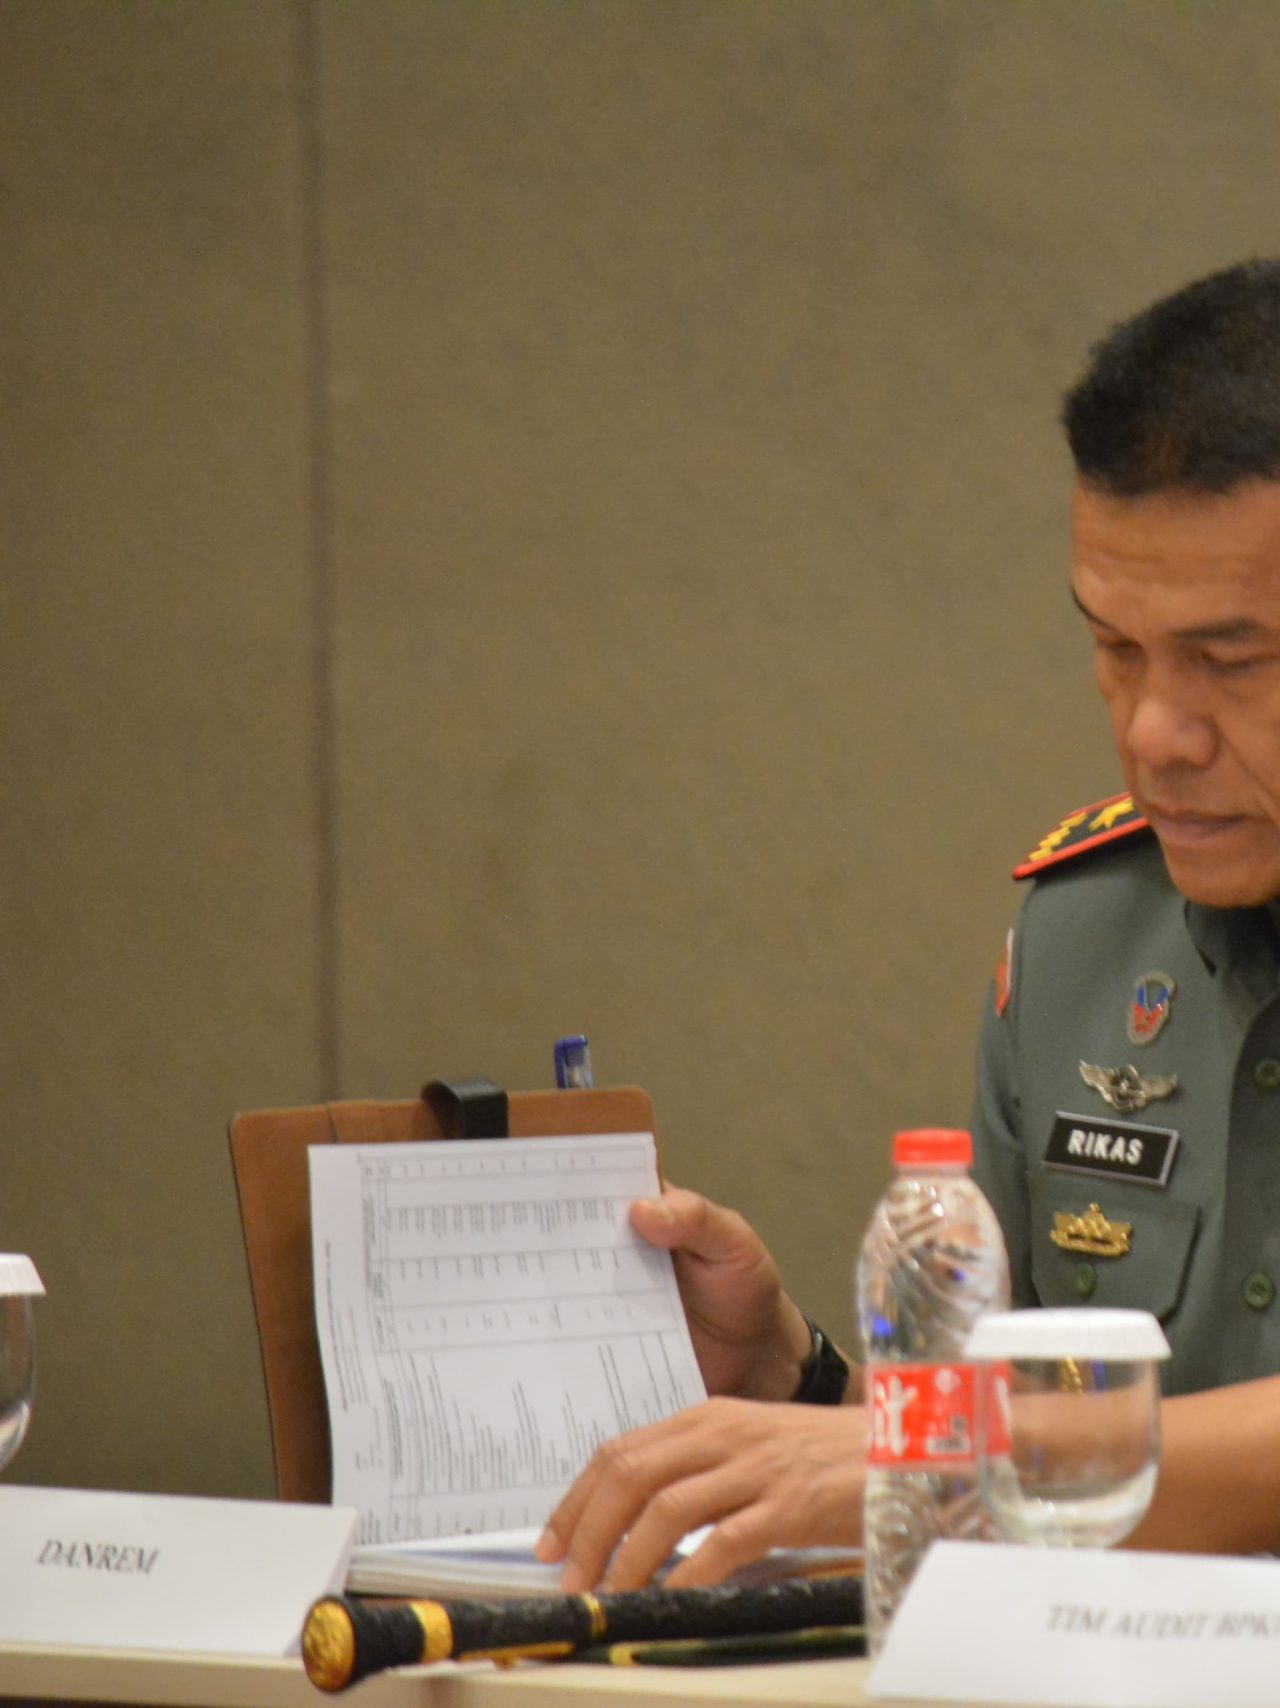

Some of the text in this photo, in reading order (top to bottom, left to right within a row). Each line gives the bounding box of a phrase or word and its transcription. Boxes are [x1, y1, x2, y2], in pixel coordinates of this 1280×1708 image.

[1067, 1129, 1144, 1165] RIKAS
[37, 1538, 159, 1574] DANREM
[1047, 1603, 1109, 1633] TIM
[1112, 1610, 1208, 1640] AUDIT
